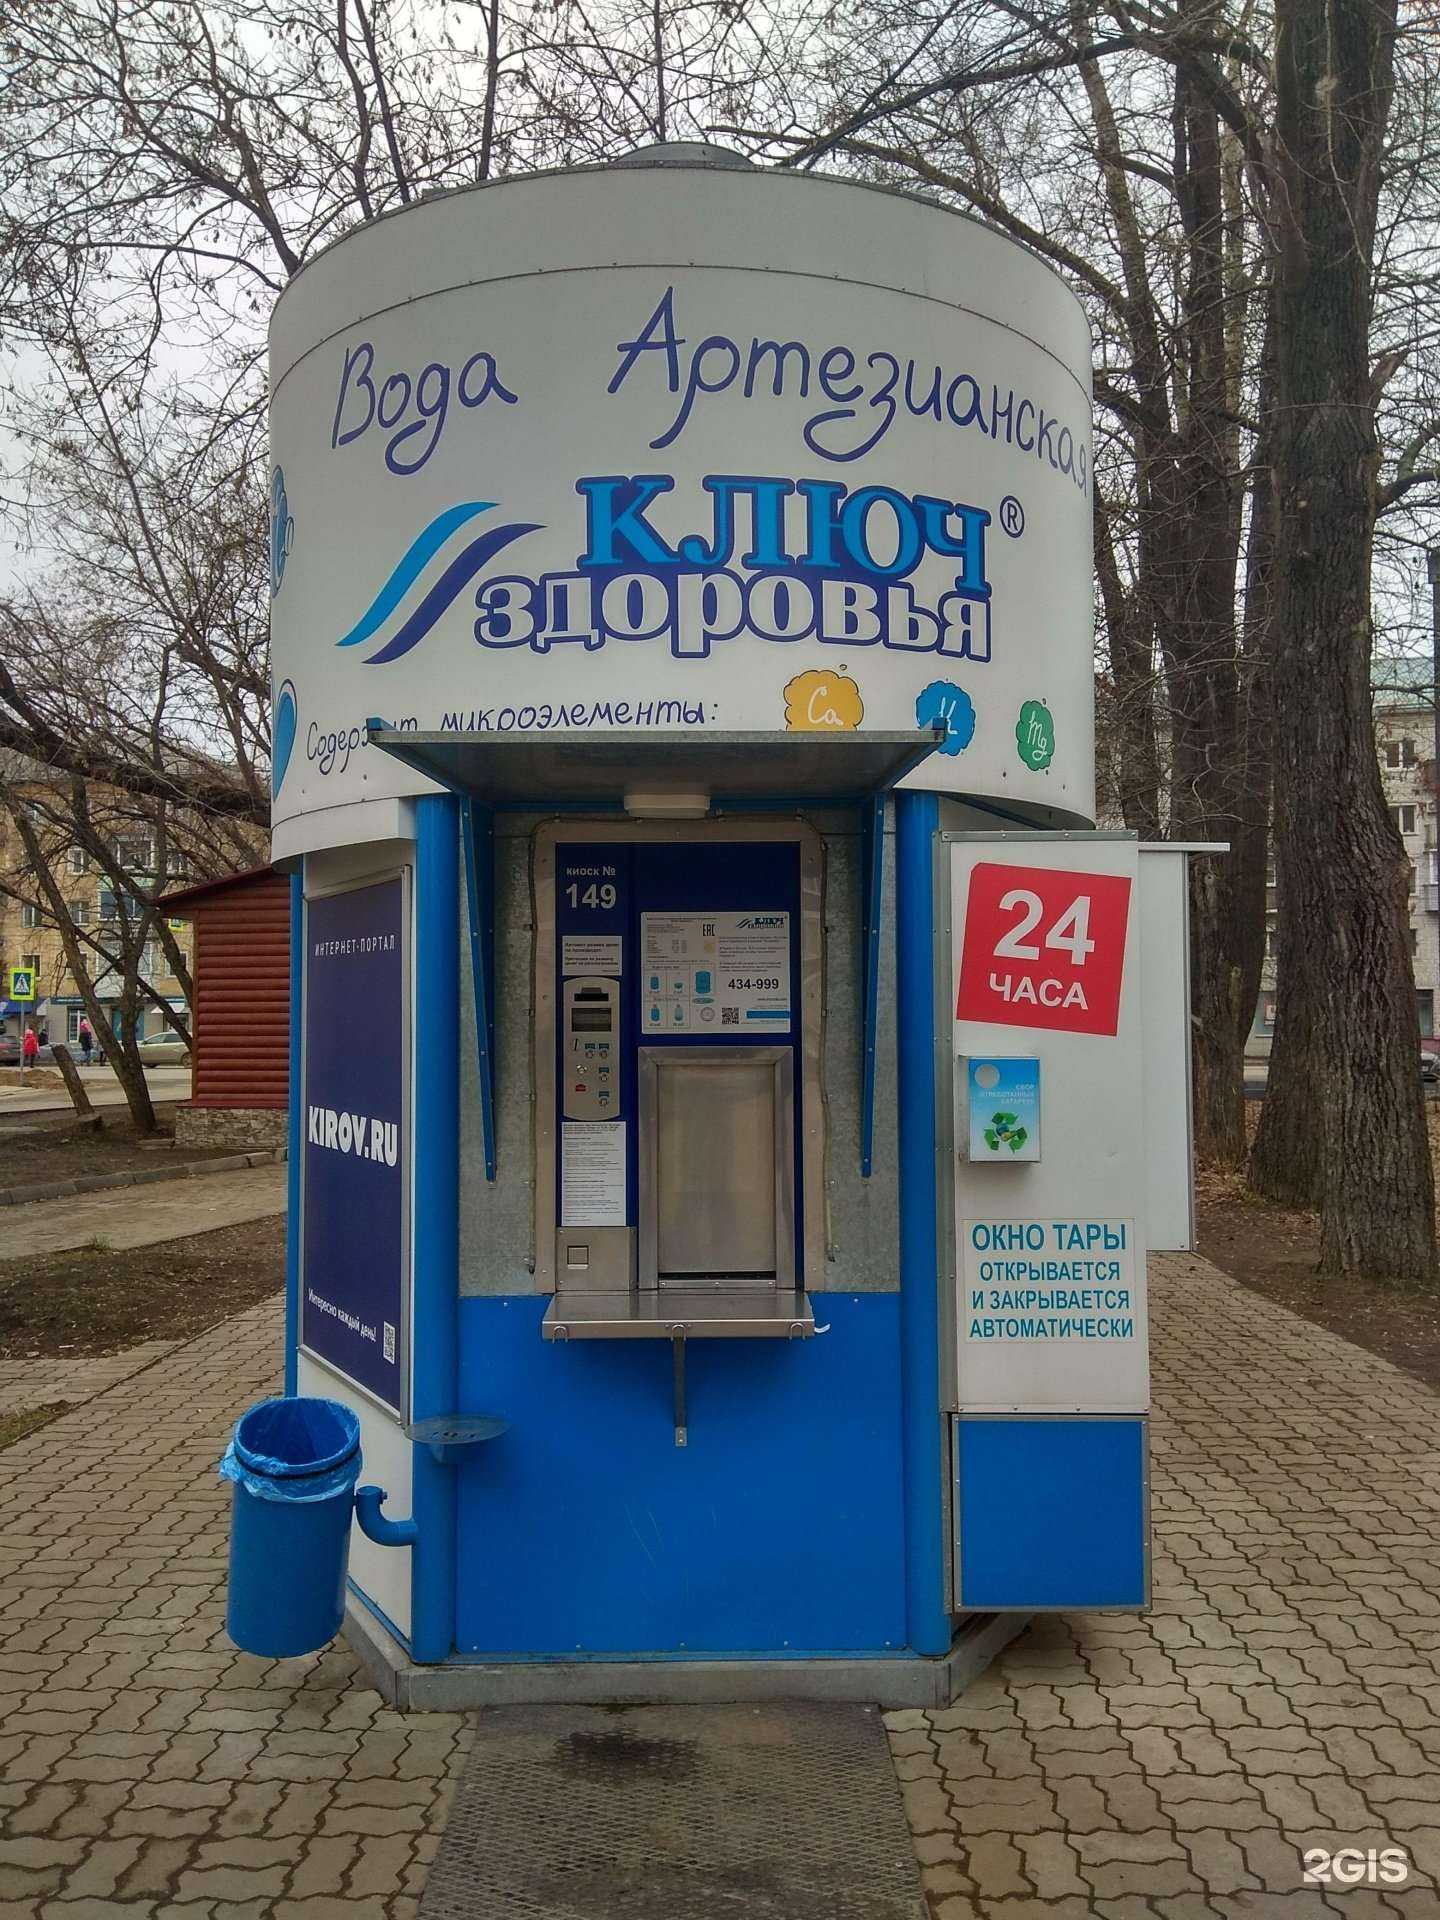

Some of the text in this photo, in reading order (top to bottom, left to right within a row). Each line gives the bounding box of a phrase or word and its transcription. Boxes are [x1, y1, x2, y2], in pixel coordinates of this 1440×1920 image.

[331, 286, 1087, 499] Вода Артезианская
[577, 474, 992, 597] КЛЮЧ
[440, 701, 719, 731] микроэлементы:
[566, 883, 616, 909] 149
[993, 889, 1095, 966] 24
[314, 934, 396, 957] ИНТЕРНЕТ-ПОРТАЛ
[728, 978, 779, 990] 434-999
[989, 973, 1089, 1011] ЧАСА
[308, 1105, 398, 1168] KIROV.RU
[972, 1223, 1126, 1251] ОКНО ТАРЫ
[979, 1261, 1120, 1282] ОТКРЫВАЕТСЯ
[972, 1290, 1130, 1310] И ЗАКРЫВАЕТСЯ
[969, 1317, 1134, 1339] АВТОМАТИЧЕСКИ
